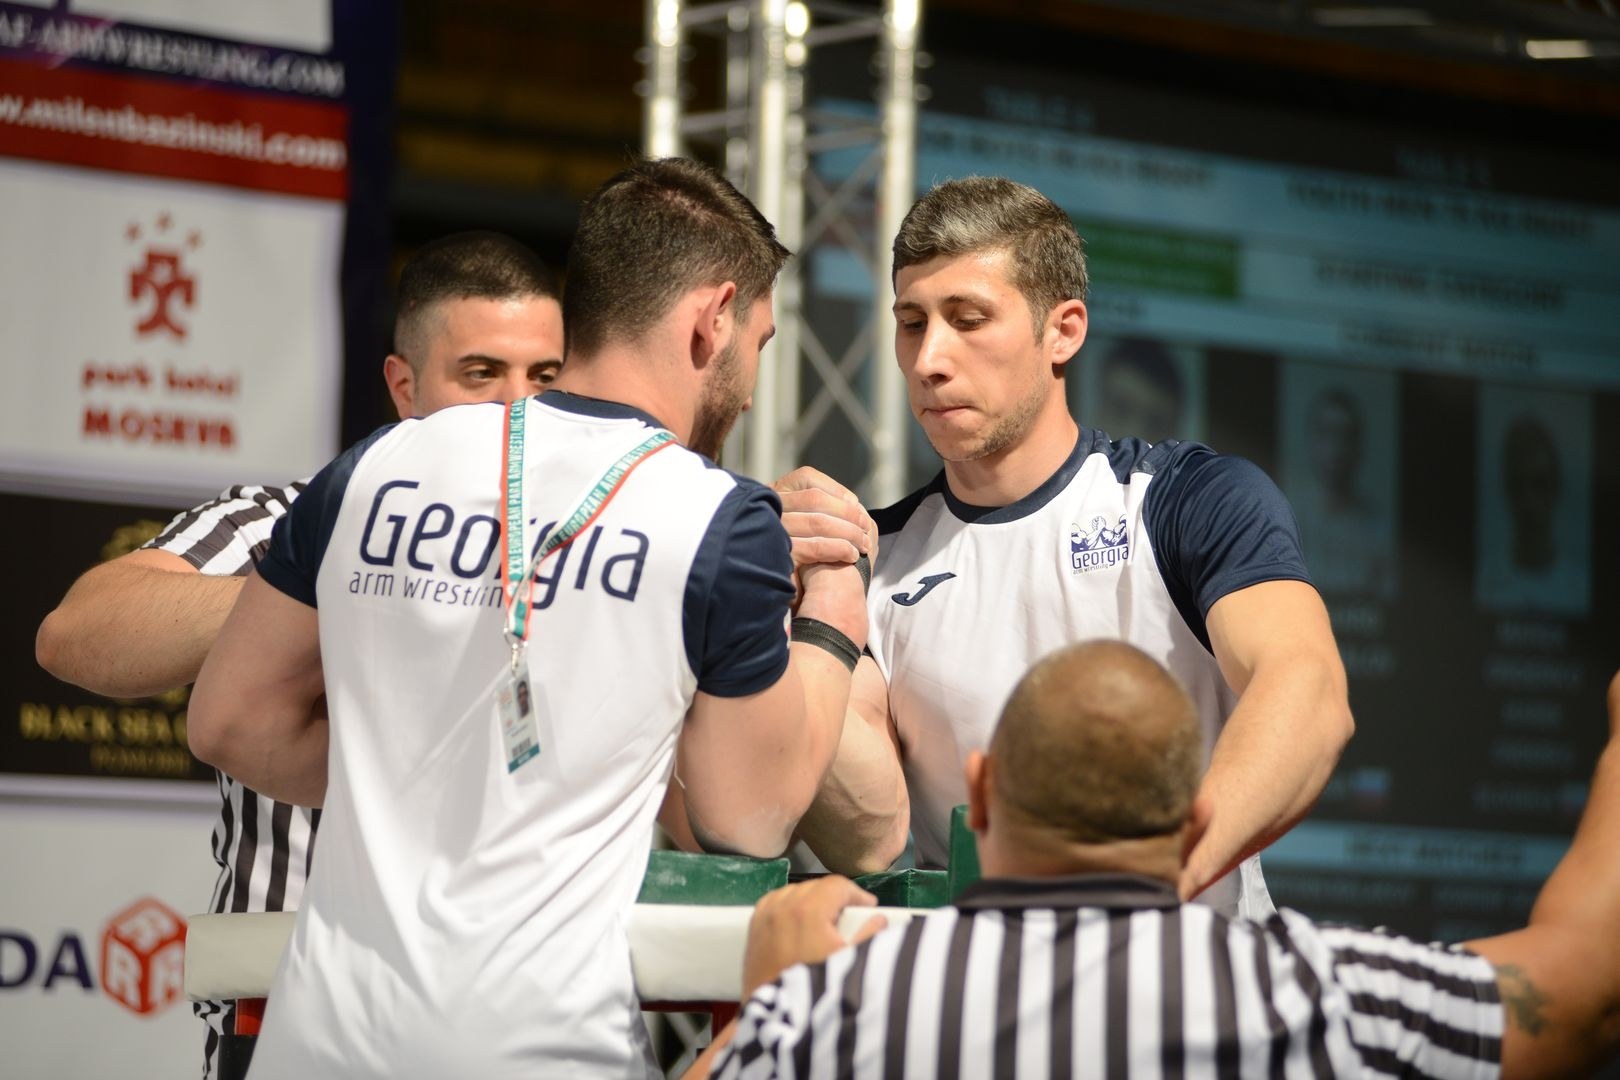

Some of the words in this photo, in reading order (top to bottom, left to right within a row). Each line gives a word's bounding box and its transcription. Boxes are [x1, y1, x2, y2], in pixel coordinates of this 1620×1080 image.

[509, 418, 524, 479] ARMWRESTLING
[508, 481, 522, 504] PARA
[558, 488, 608, 541] EUROPEAN
[359, 480, 650, 610] Geogia
[508, 506, 522, 554] EUROPEAN
[1071, 546, 1129, 569] Georgia
[349, 571, 394, 595] arm
[403, 575, 505, 609] wrestlin
